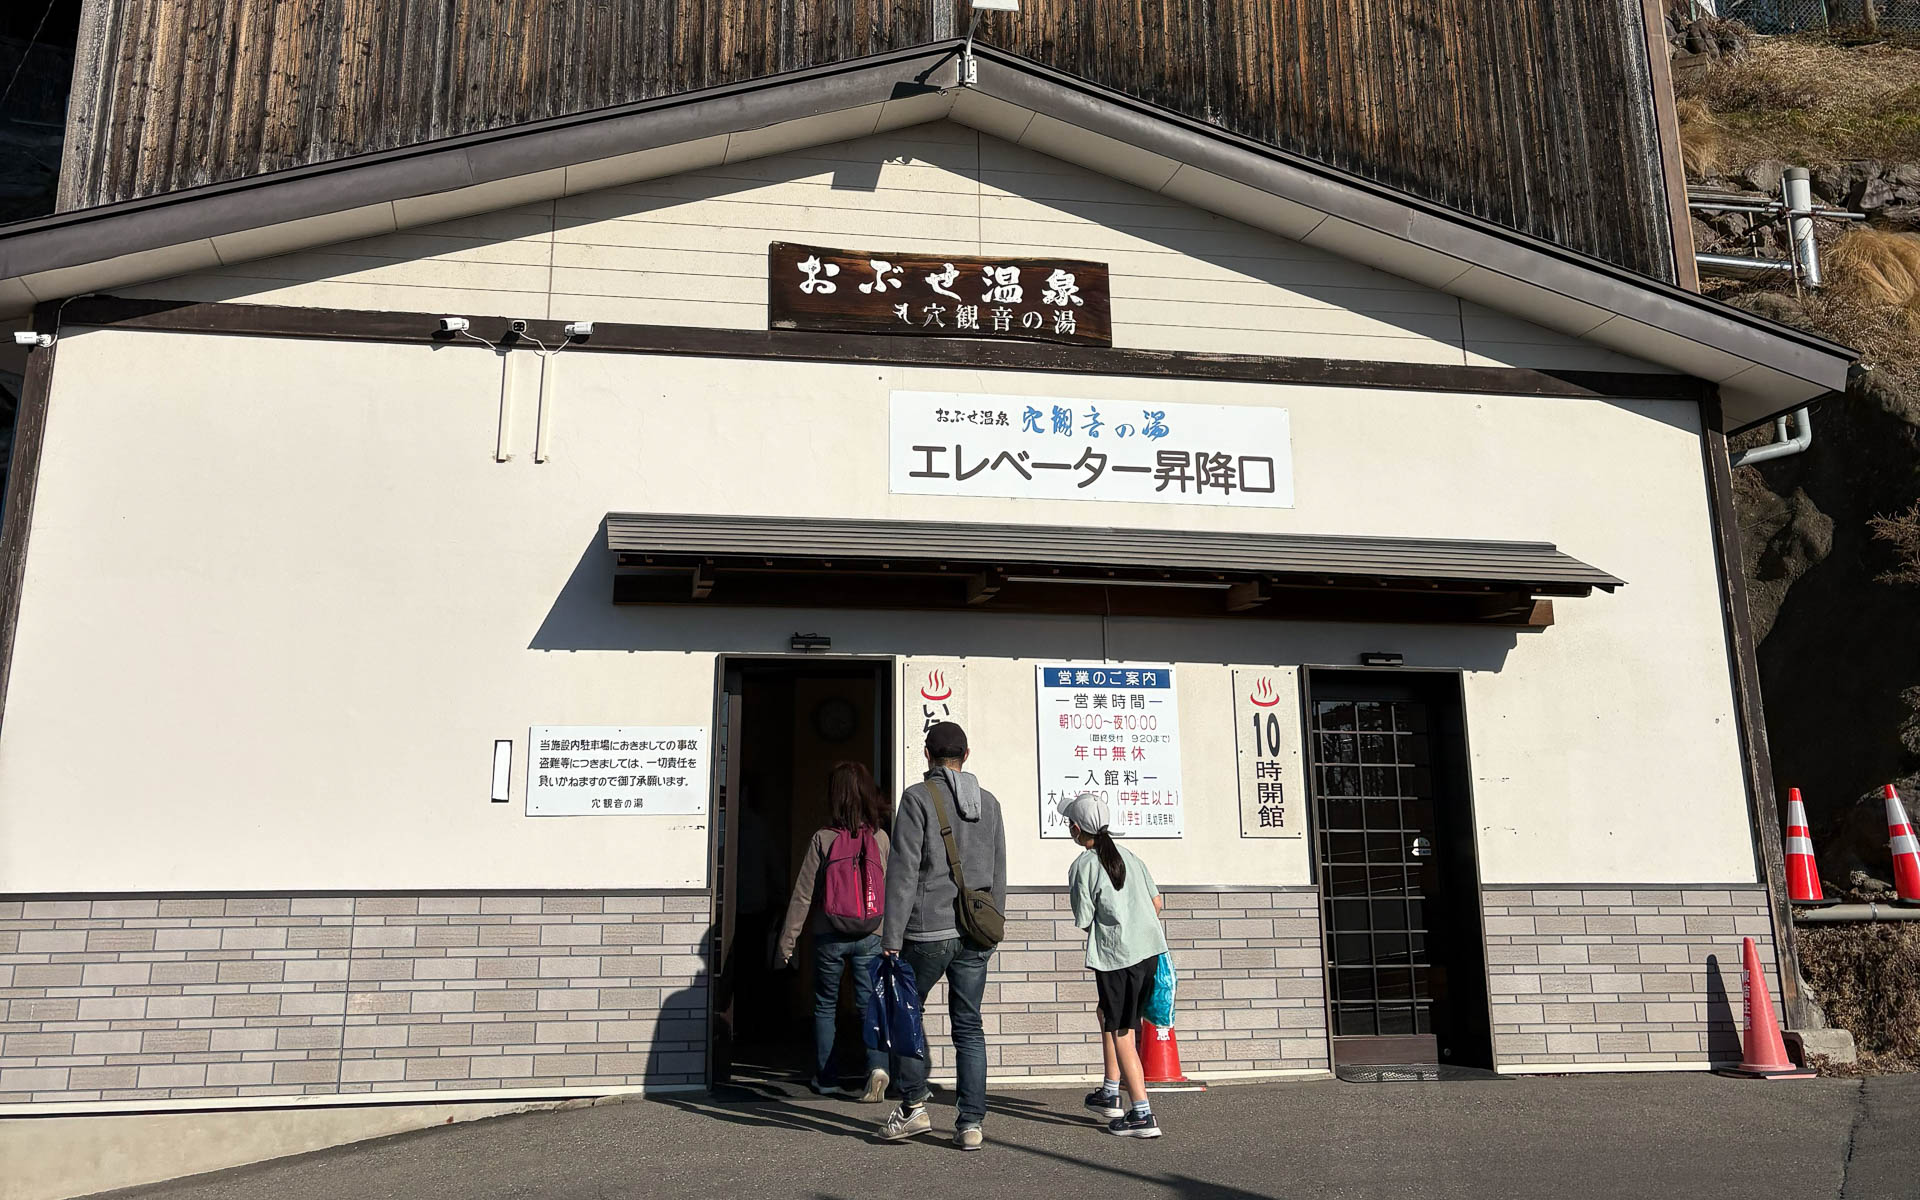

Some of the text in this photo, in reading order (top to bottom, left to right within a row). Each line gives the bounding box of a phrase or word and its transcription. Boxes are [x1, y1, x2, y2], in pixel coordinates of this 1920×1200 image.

[797, 255, 1084, 307] おぶせ温泉
[922, 303, 1077, 335] 穴観音の湯
[935, 405, 1170, 442] おぶせ温泉 穴観音の湯
[909, 444, 1275, 496] エレベーター昇降口
[1058, 670, 1157, 686] 営業のご案内
[1074, 745, 1146, 762] 年中無休
[1252, 712, 1286, 828] 10時開館
[591, 798, 644, 809] 穴観音の湯
